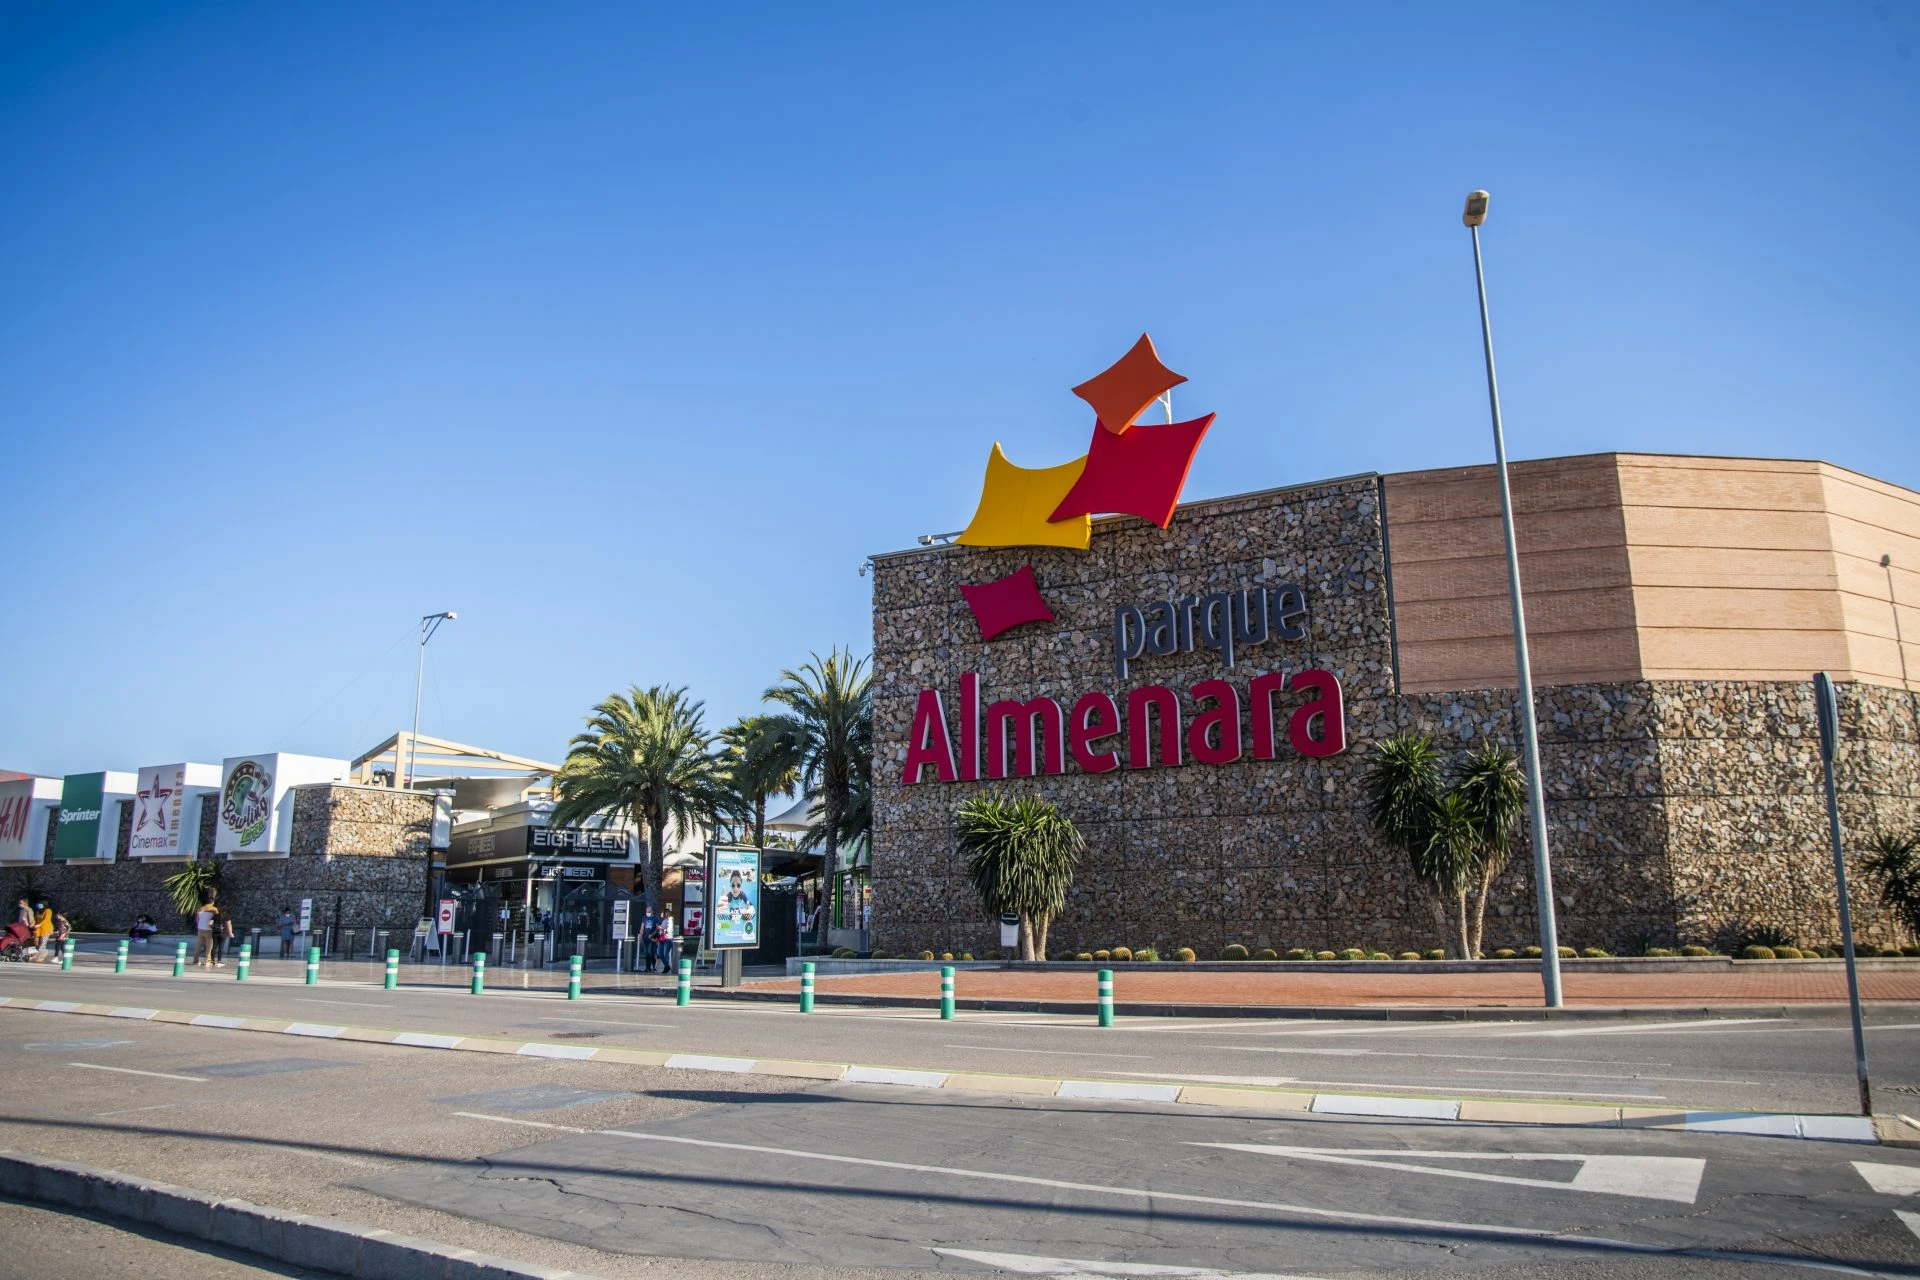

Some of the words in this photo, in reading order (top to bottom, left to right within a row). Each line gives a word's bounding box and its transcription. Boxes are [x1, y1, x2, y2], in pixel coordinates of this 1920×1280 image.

[1114, 583, 1306, 680] parque
[902, 669, 1347, 785] Almenara
[60, 808, 101, 825] Sprinter
[222, 797, 269, 829] Bowling
[132, 834, 169, 849] Cinemax
